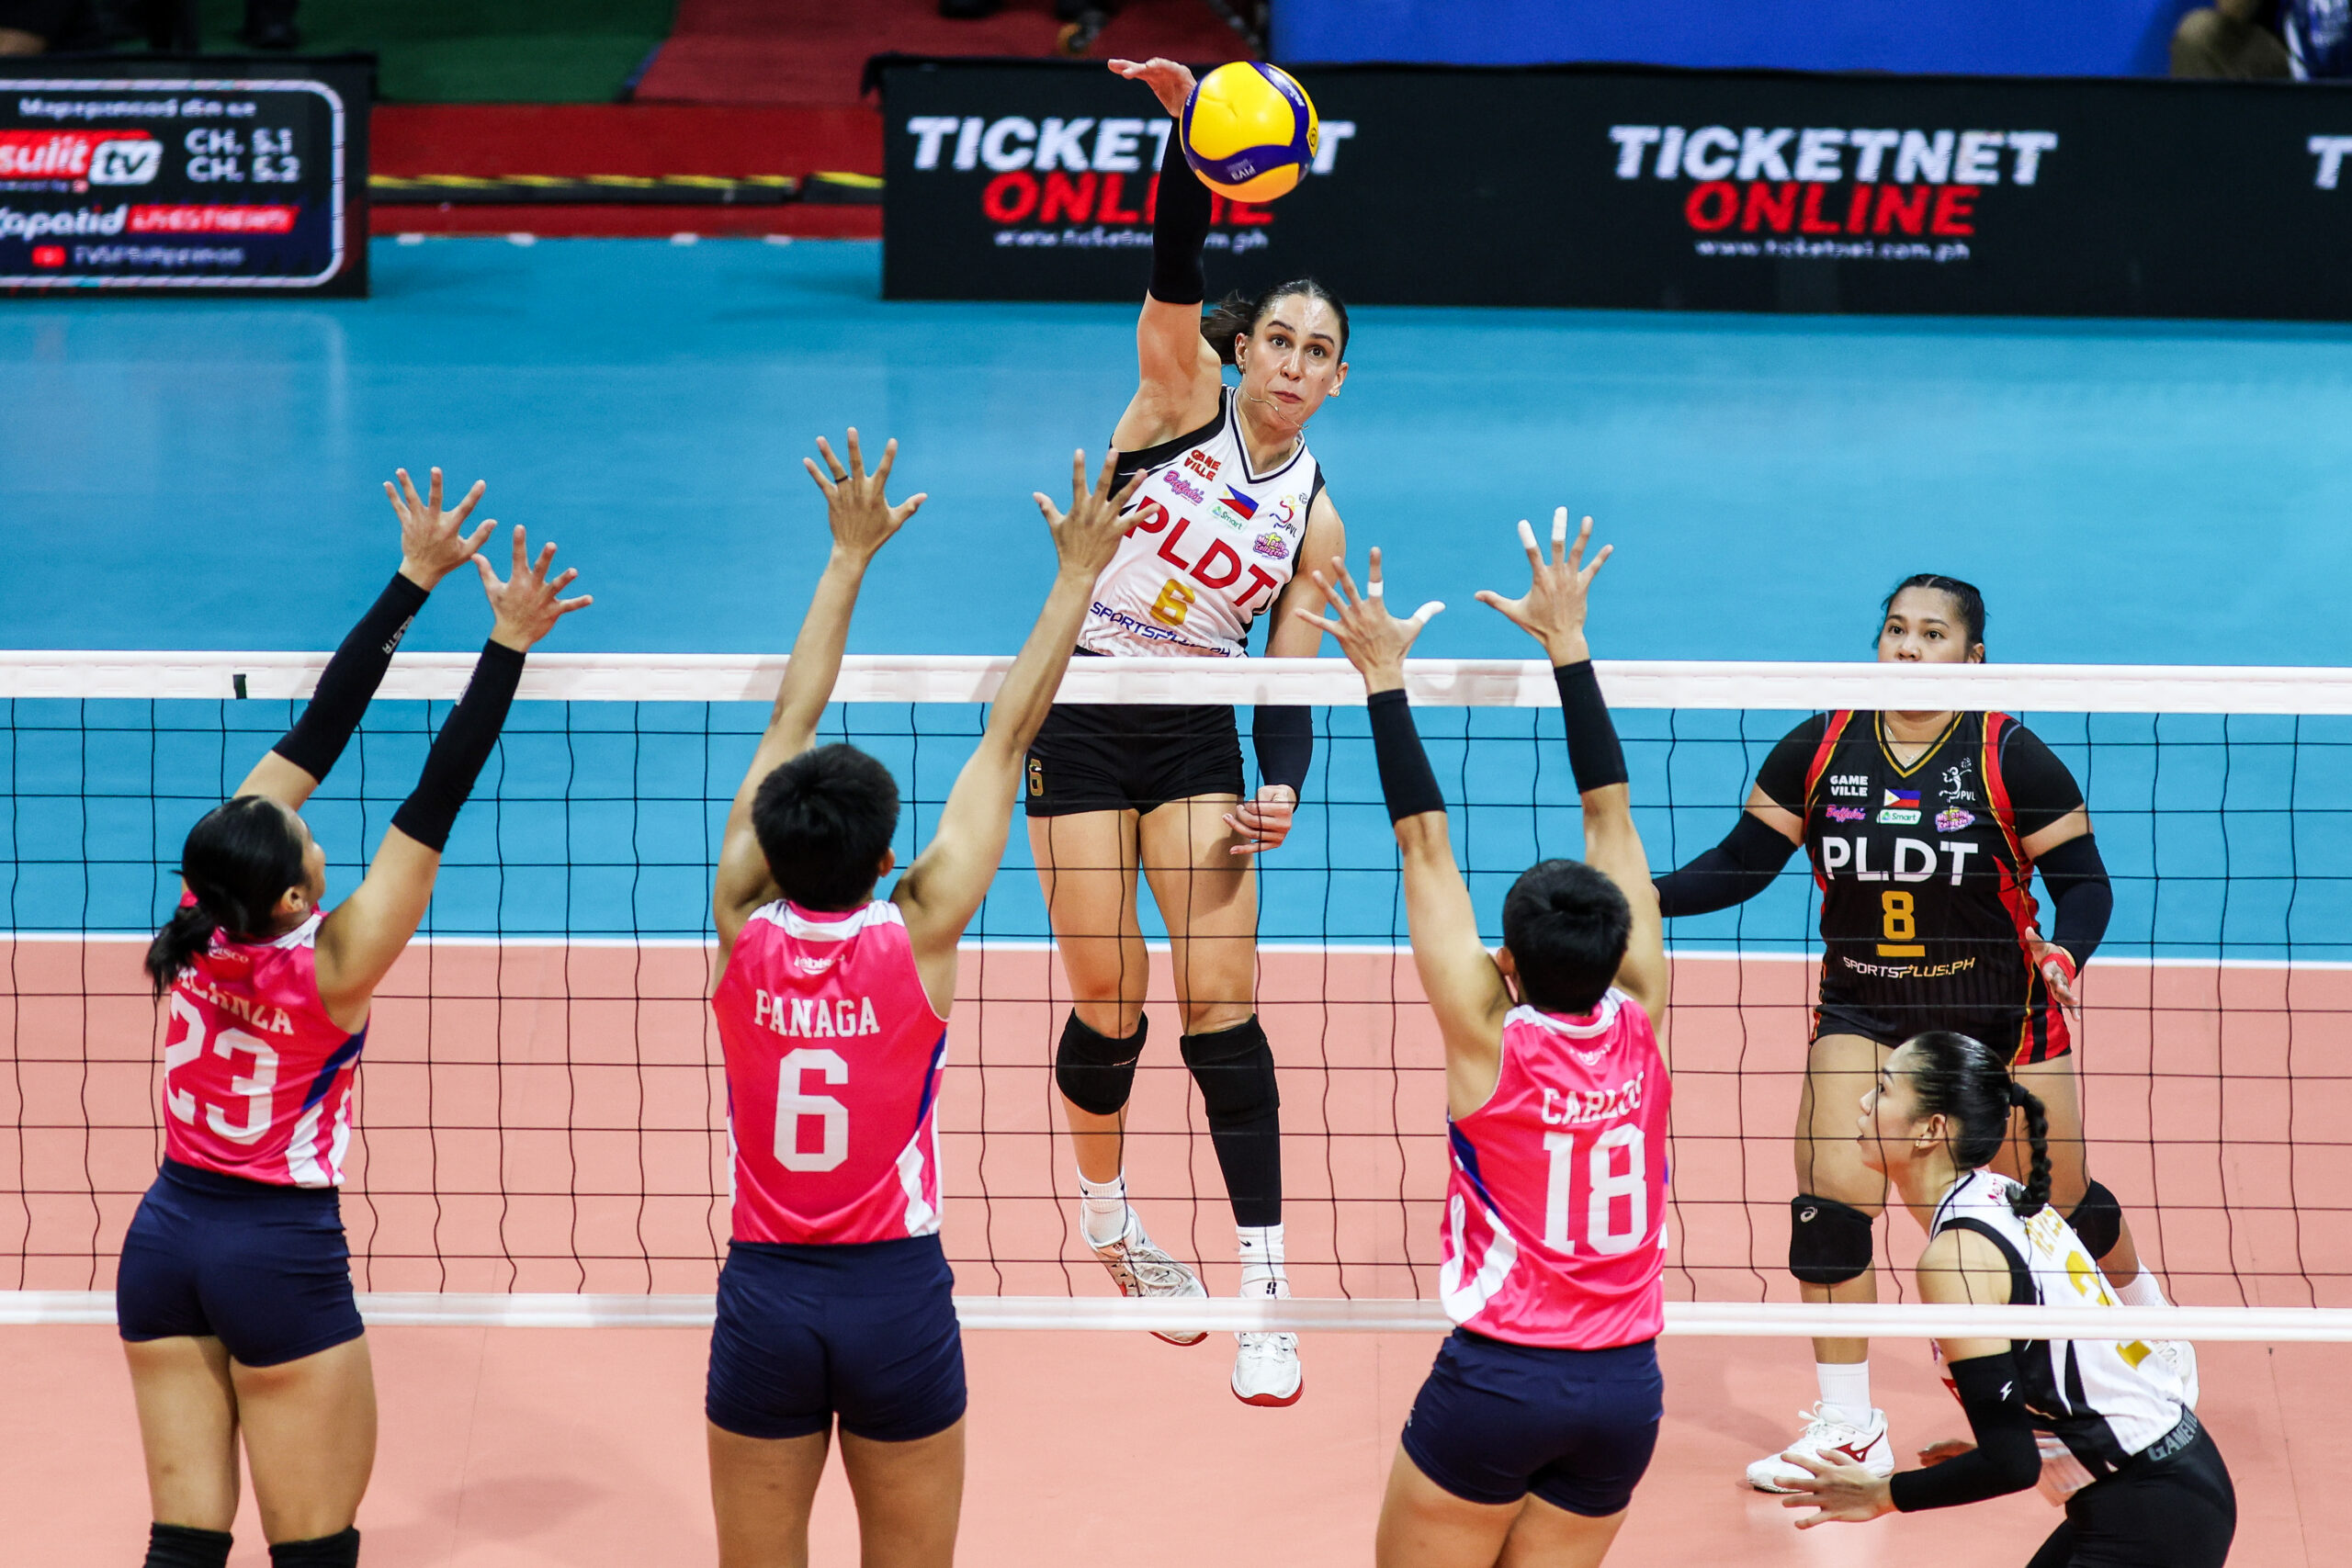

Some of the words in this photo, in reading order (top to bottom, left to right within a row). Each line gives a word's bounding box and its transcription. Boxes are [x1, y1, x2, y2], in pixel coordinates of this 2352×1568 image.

[907, 117, 1355, 174] TICKETT
[1610, 125, 2059, 185] TICKETNET
[1684, 180, 1981, 236] ONLINE
[1220, 511, 1243, 530] Smart
[1125, 496, 1278, 607] PLDT
[1150, 579, 1195, 626] 6
[1829, 774, 1869, 785] GAME
[1830, 785, 1868, 796] VILLE
[1961, 790, 1976, 801] PVL
[1892, 812, 1917, 821] Smart
[1823, 836, 1978, 886] PLDT
[1881, 890, 1916, 941] 8
[1843, 956, 1975, 979] SPORTSPLUS.PH
[754, 989, 880, 1038] PANAGA
[164, 990, 278, 1145] 23
[774, 1048, 849, 1172] 6
[1544, 1122, 1647, 1256] 18
